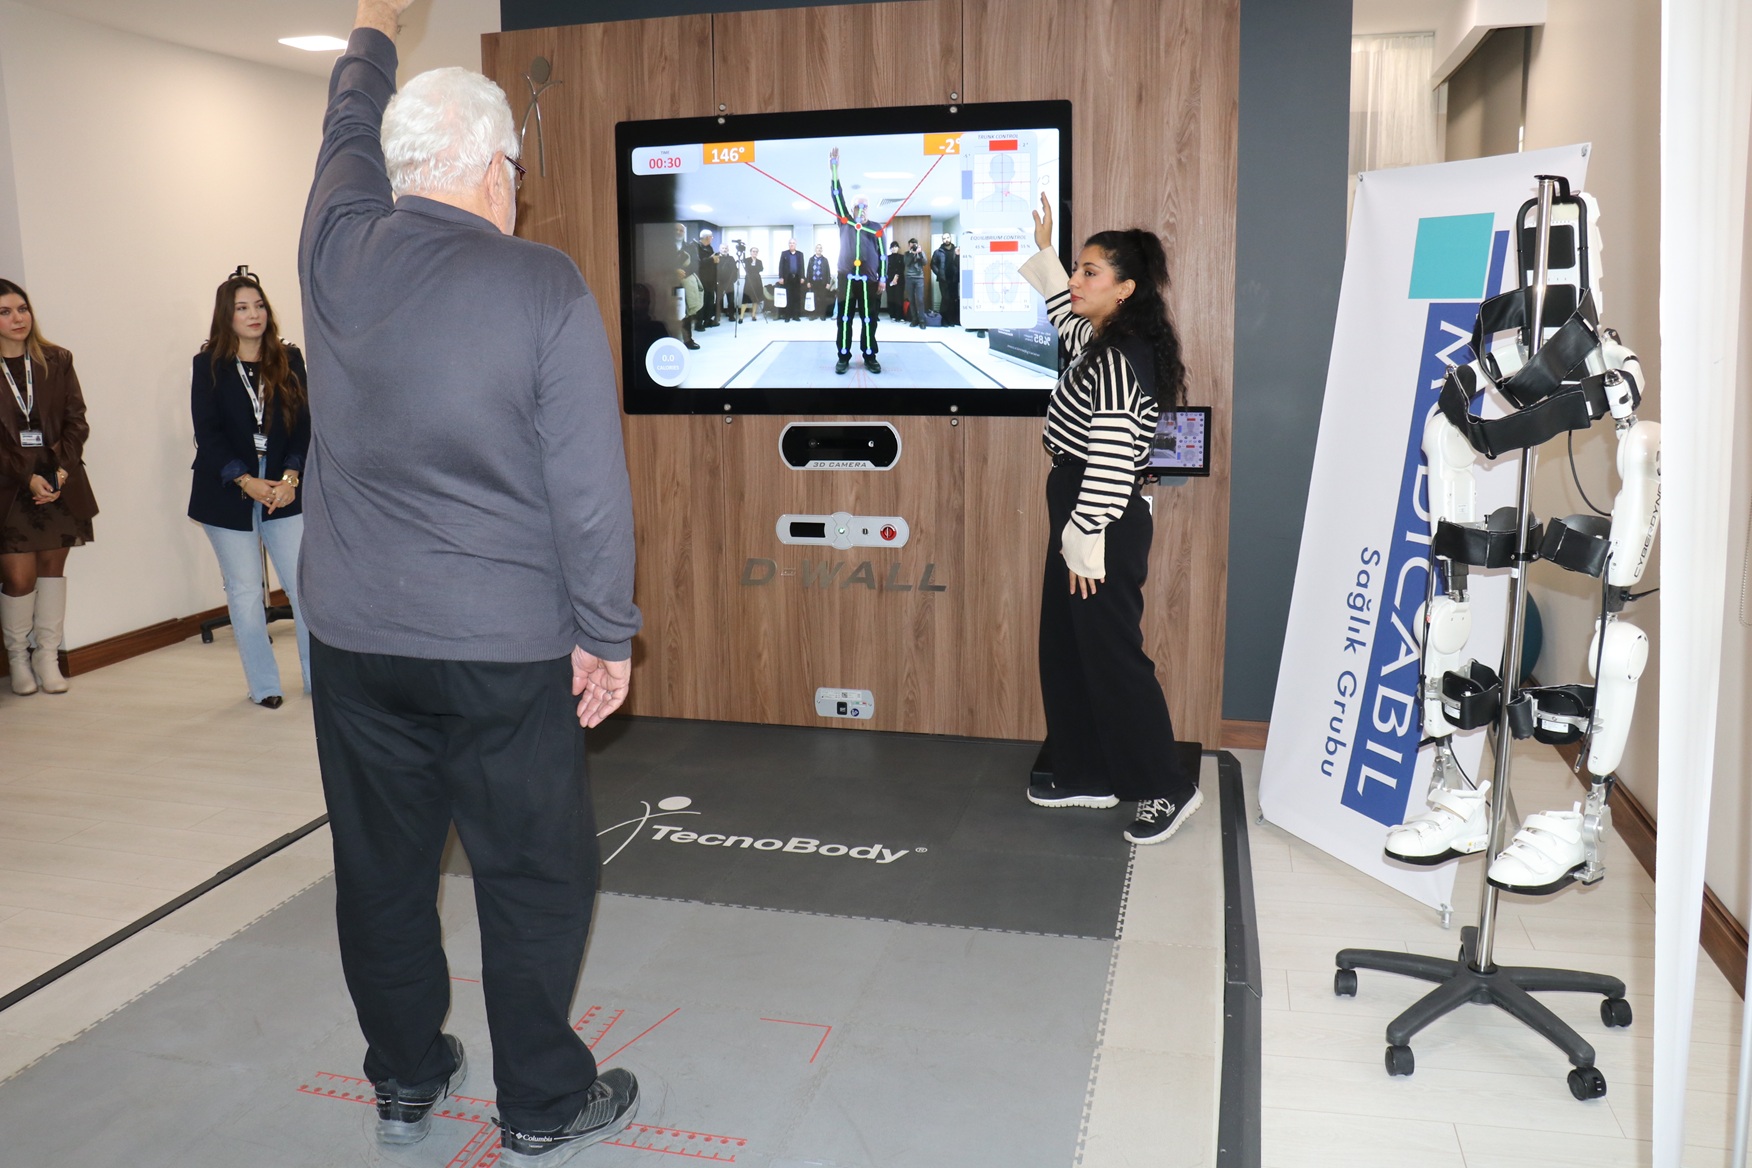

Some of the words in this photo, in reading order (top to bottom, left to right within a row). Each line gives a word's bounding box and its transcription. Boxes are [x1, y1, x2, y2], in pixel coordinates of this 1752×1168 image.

[649, 157, 681, 169] 00:30
[711, 146, 745, 163] 146°
[662, 354, 675, 362] 0.0
[740, 558, 947, 592] D-WALL
[1357, 320, 1474, 797] MICABIL
[1344, 547, 1381, 654] Sağlık
[1321, 670, 1357, 777] Grubu
[652, 825, 910, 864] TecnoBody
[522, 1133, 553, 1142] Columbia
